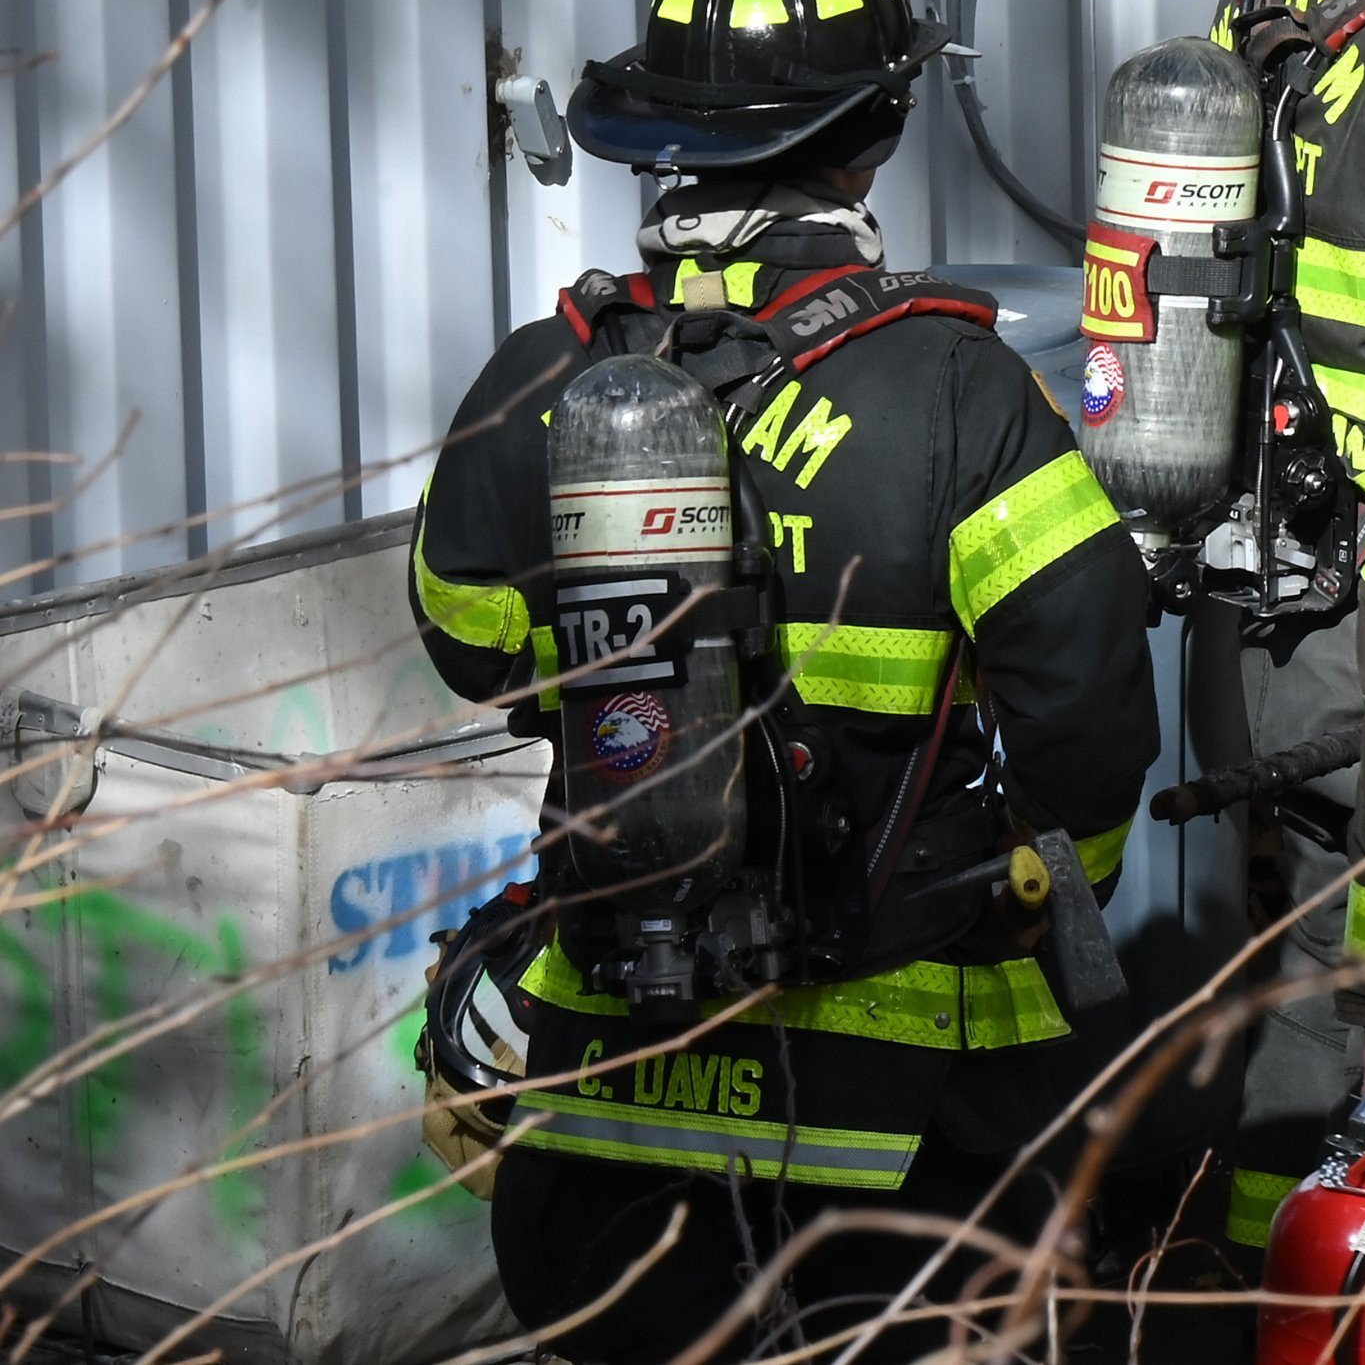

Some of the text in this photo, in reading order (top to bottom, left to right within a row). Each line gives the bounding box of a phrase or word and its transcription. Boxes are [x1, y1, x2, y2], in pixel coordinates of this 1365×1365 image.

[1177, 201, 1237, 209] SAFETY
[1180, 183, 1245, 200] SCOTT
[791, 288, 860, 336] 3M
[559, 603, 657, 666] TR-2
[578, 1039, 763, 1117] C. DAVIS
